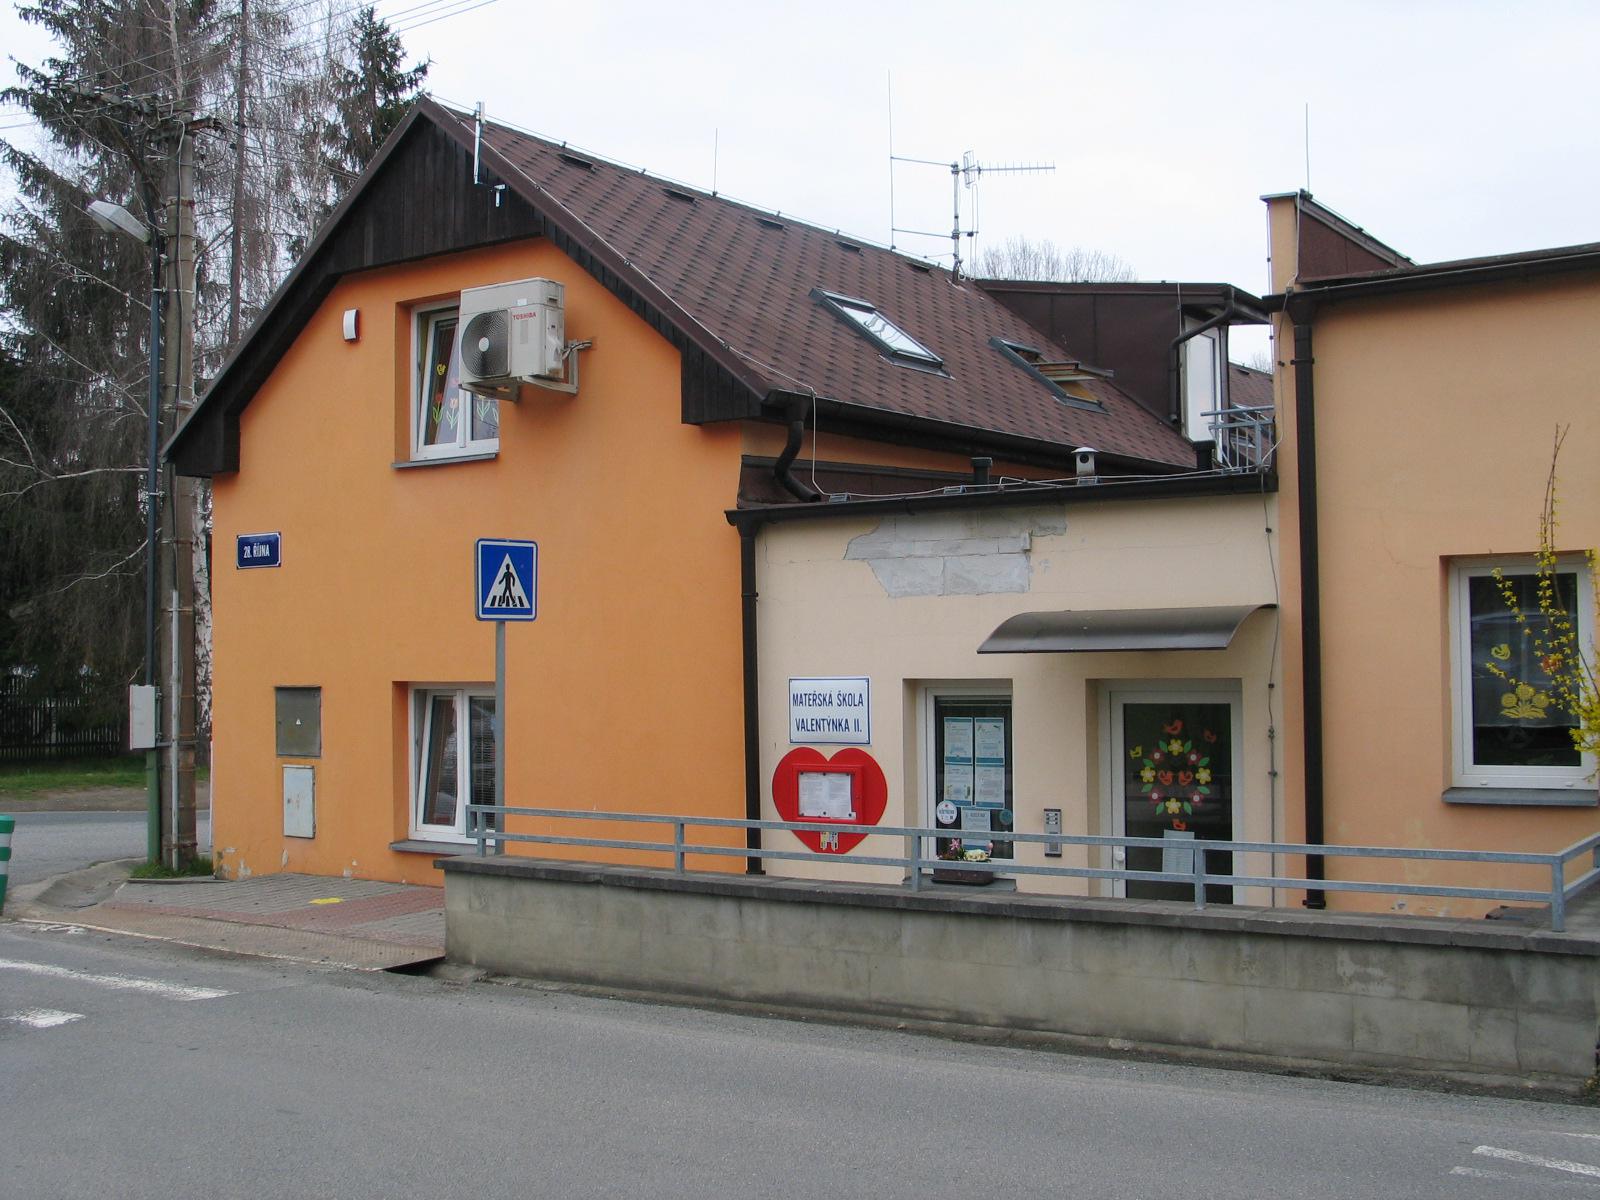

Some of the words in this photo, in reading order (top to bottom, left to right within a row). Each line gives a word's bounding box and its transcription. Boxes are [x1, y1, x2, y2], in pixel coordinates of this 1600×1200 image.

[512, 312, 537, 320] TOSHIBA
[792, 690, 833, 707] MATEŘSKÁ
[837, 690, 864, 707] ŠKOLA
[795, 716, 850, 732] VALENTÝNKA
[854, 718, 862, 732] II.
